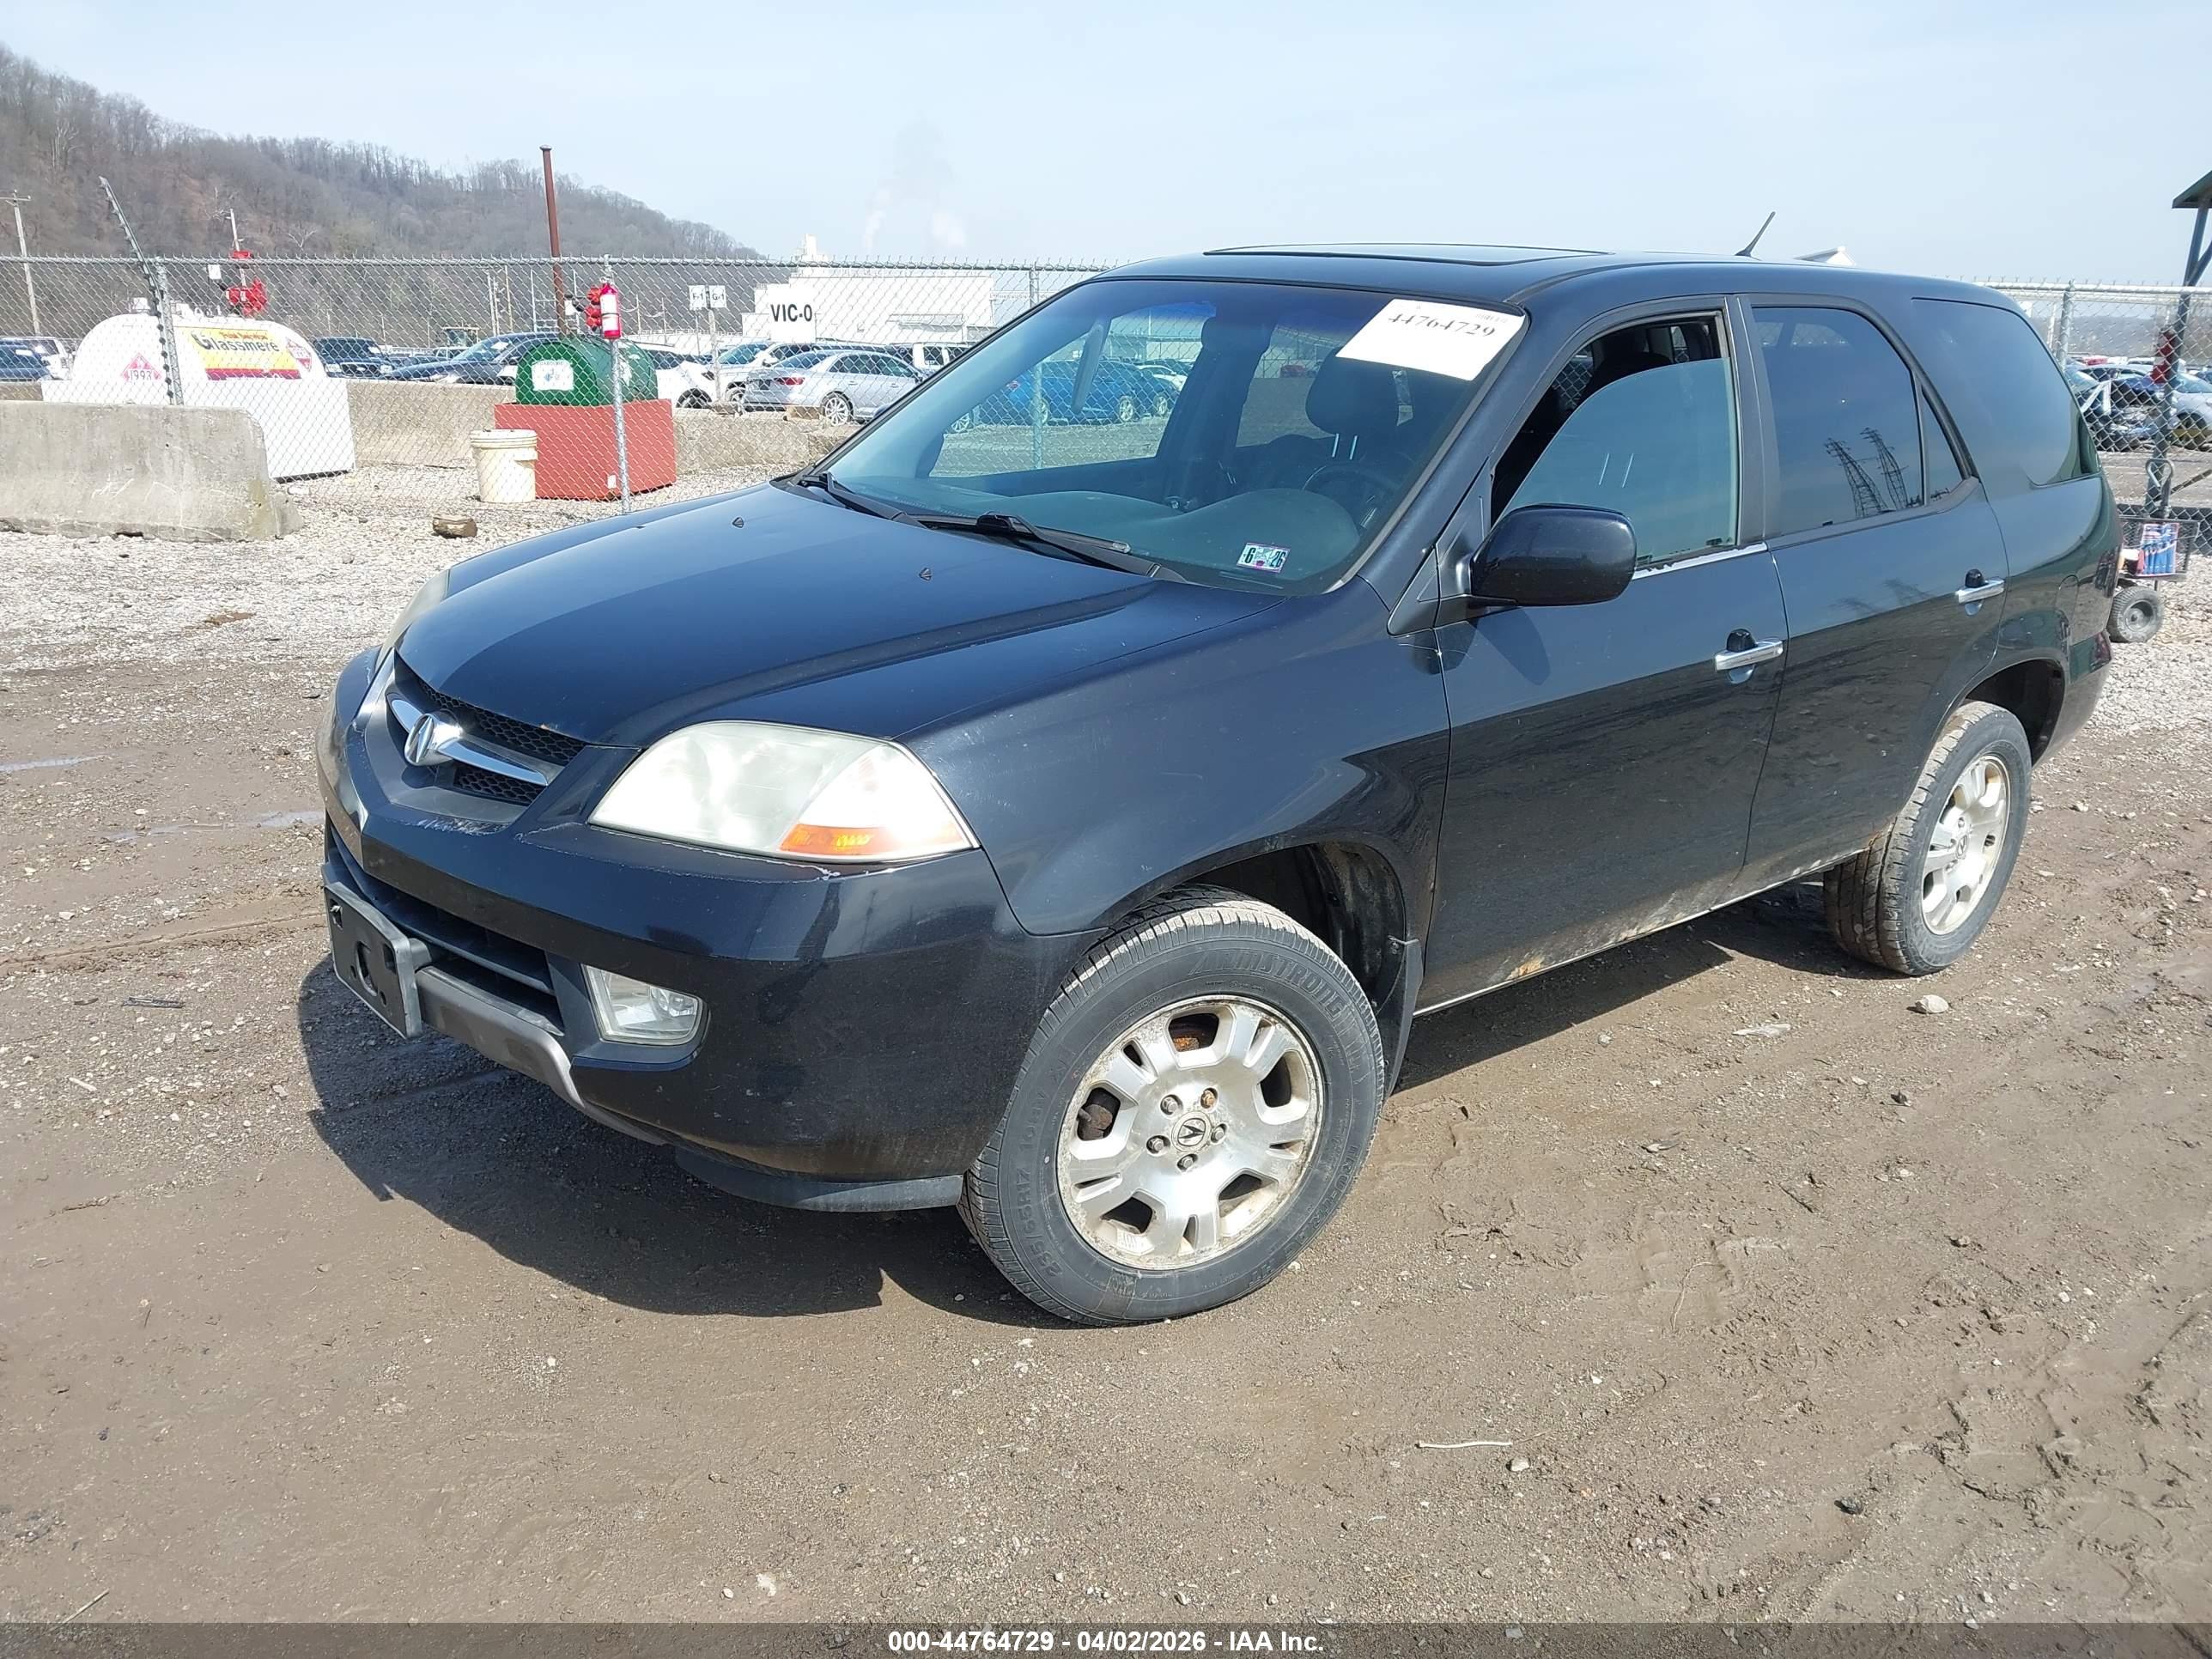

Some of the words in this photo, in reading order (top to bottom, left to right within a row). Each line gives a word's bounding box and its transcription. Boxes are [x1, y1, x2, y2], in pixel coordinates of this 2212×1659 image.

[1388, 313, 1496, 337] 44764729
[191, 332, 280, 352] Glassmere
[131, 369, 152, 380] 1993
[1244, 547, 1256, 563] 6
[1269, 550, 1286, 568] 26
[1188, 949, 1346, 1020] ARMSTRONG
